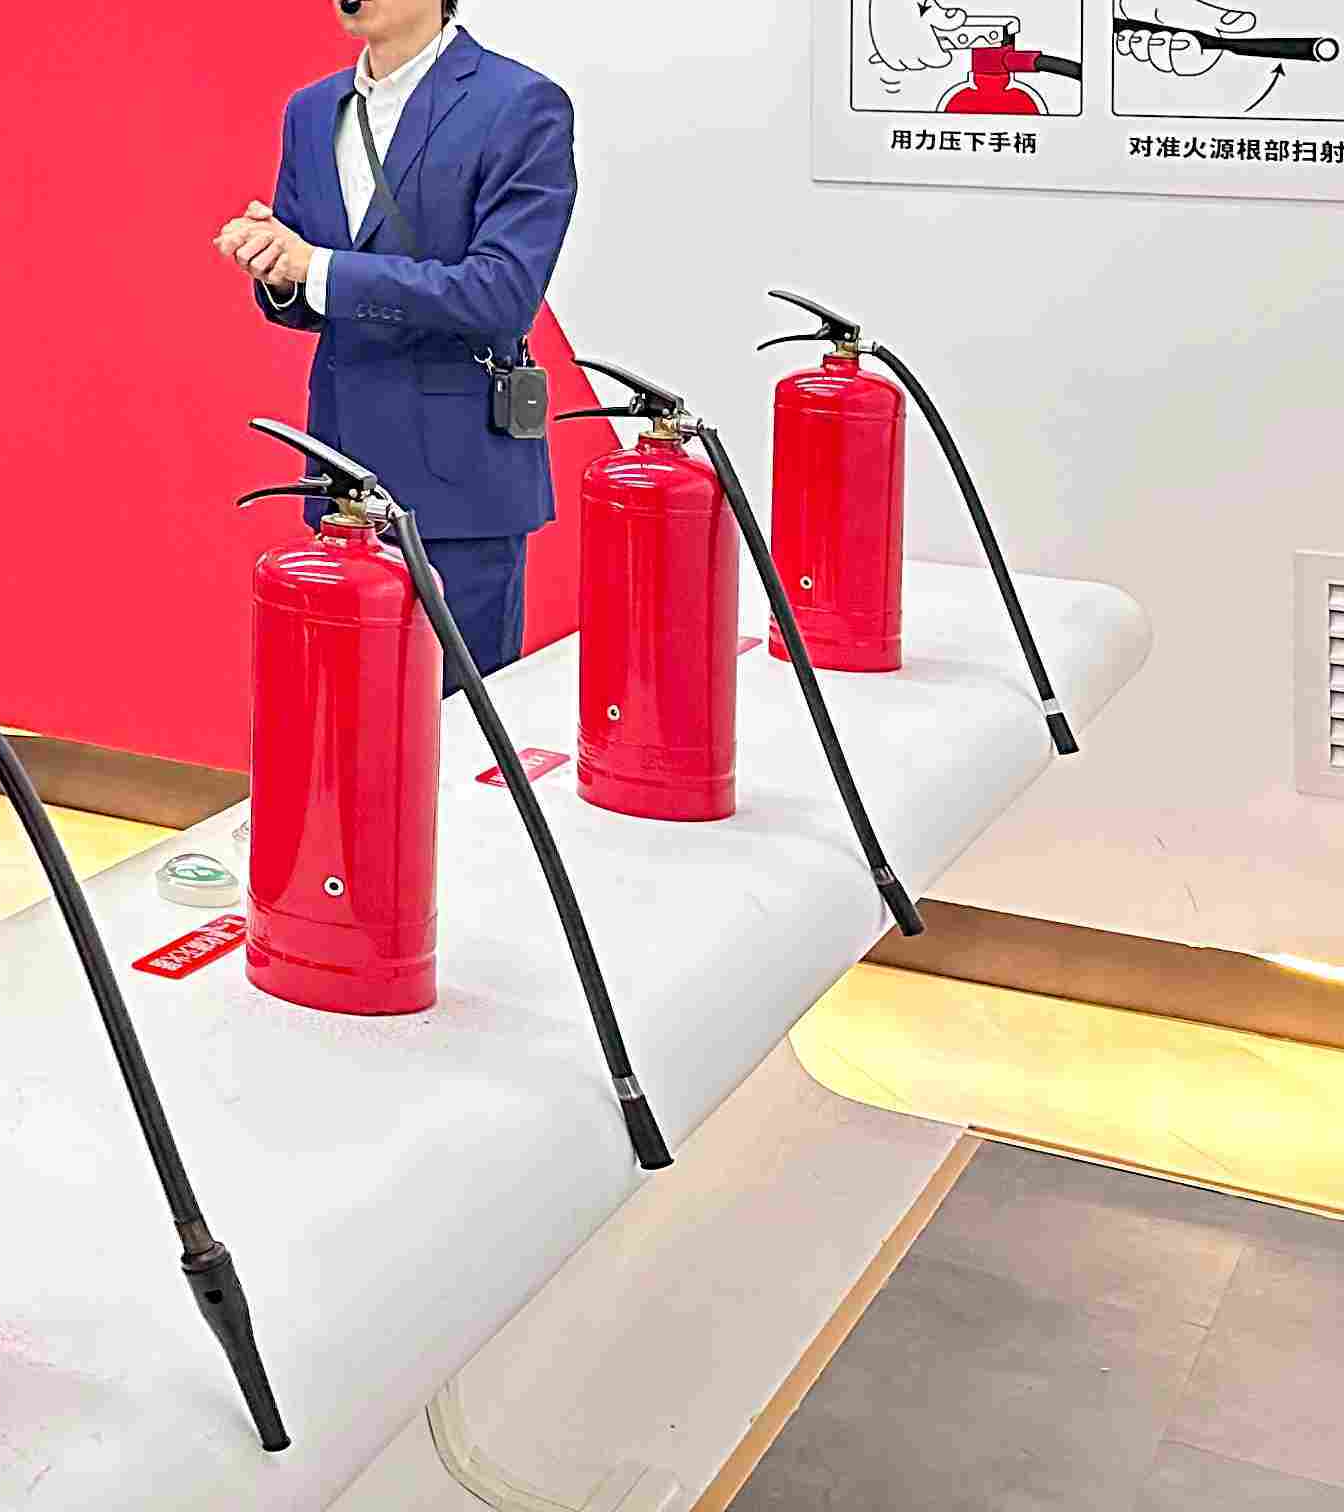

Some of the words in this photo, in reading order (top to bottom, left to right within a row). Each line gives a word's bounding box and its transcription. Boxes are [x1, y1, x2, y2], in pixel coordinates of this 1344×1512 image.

[891, 129, 1037, 154] 用力压下手柄
[1129, 135, 1344, 164] 对准火源根部扫射
